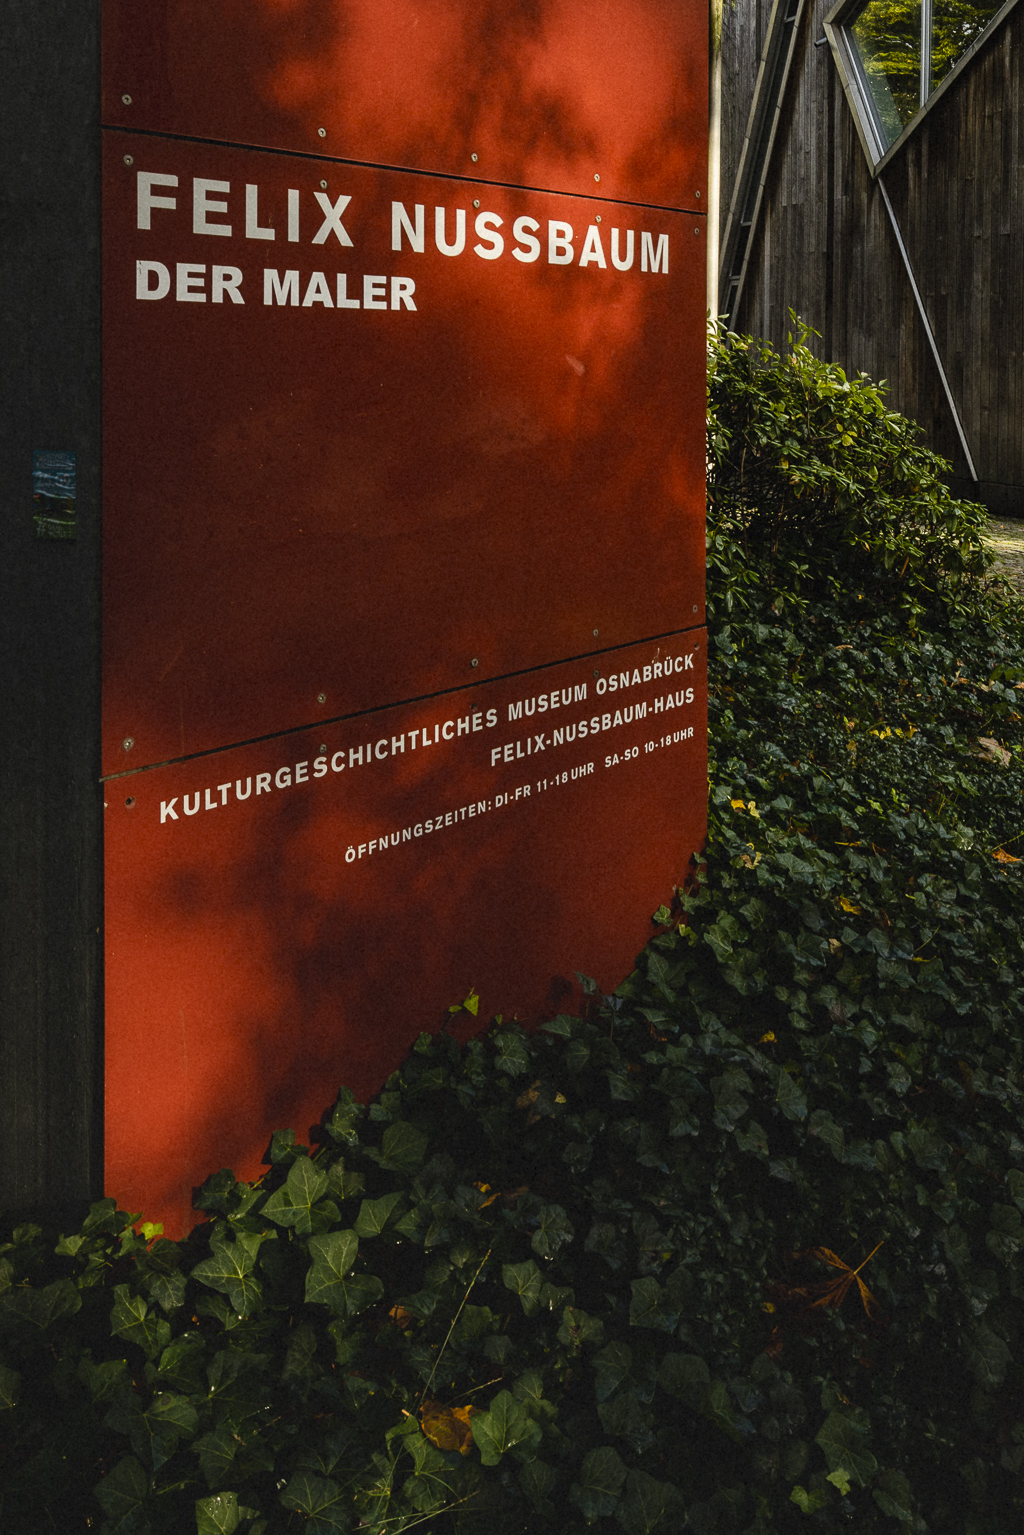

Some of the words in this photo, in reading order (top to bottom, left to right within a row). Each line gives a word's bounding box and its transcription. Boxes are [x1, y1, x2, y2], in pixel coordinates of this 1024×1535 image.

[136, 170, 355, 248] FELIX
[391, 200, 670, 275] NUSSBAUM
[135, 259, 246, 305] DER
[263, 268, 418, 312] MALER
[159, 708, 498, 824] KULTURGESCHICHTLICHES
[508, 682, 588, 722] MUSEUM
[595, 652, 694, 697] OSNABRÜCK
[491, 687, 695, 767] FELIX-NUSSBAUM-HAUS
[344, 799, 492, 864] ÖFFNUNGSZEITEN:
[495, 784, 531, 808] DI-FR
[604, 746, 640, 768] SA-SO
